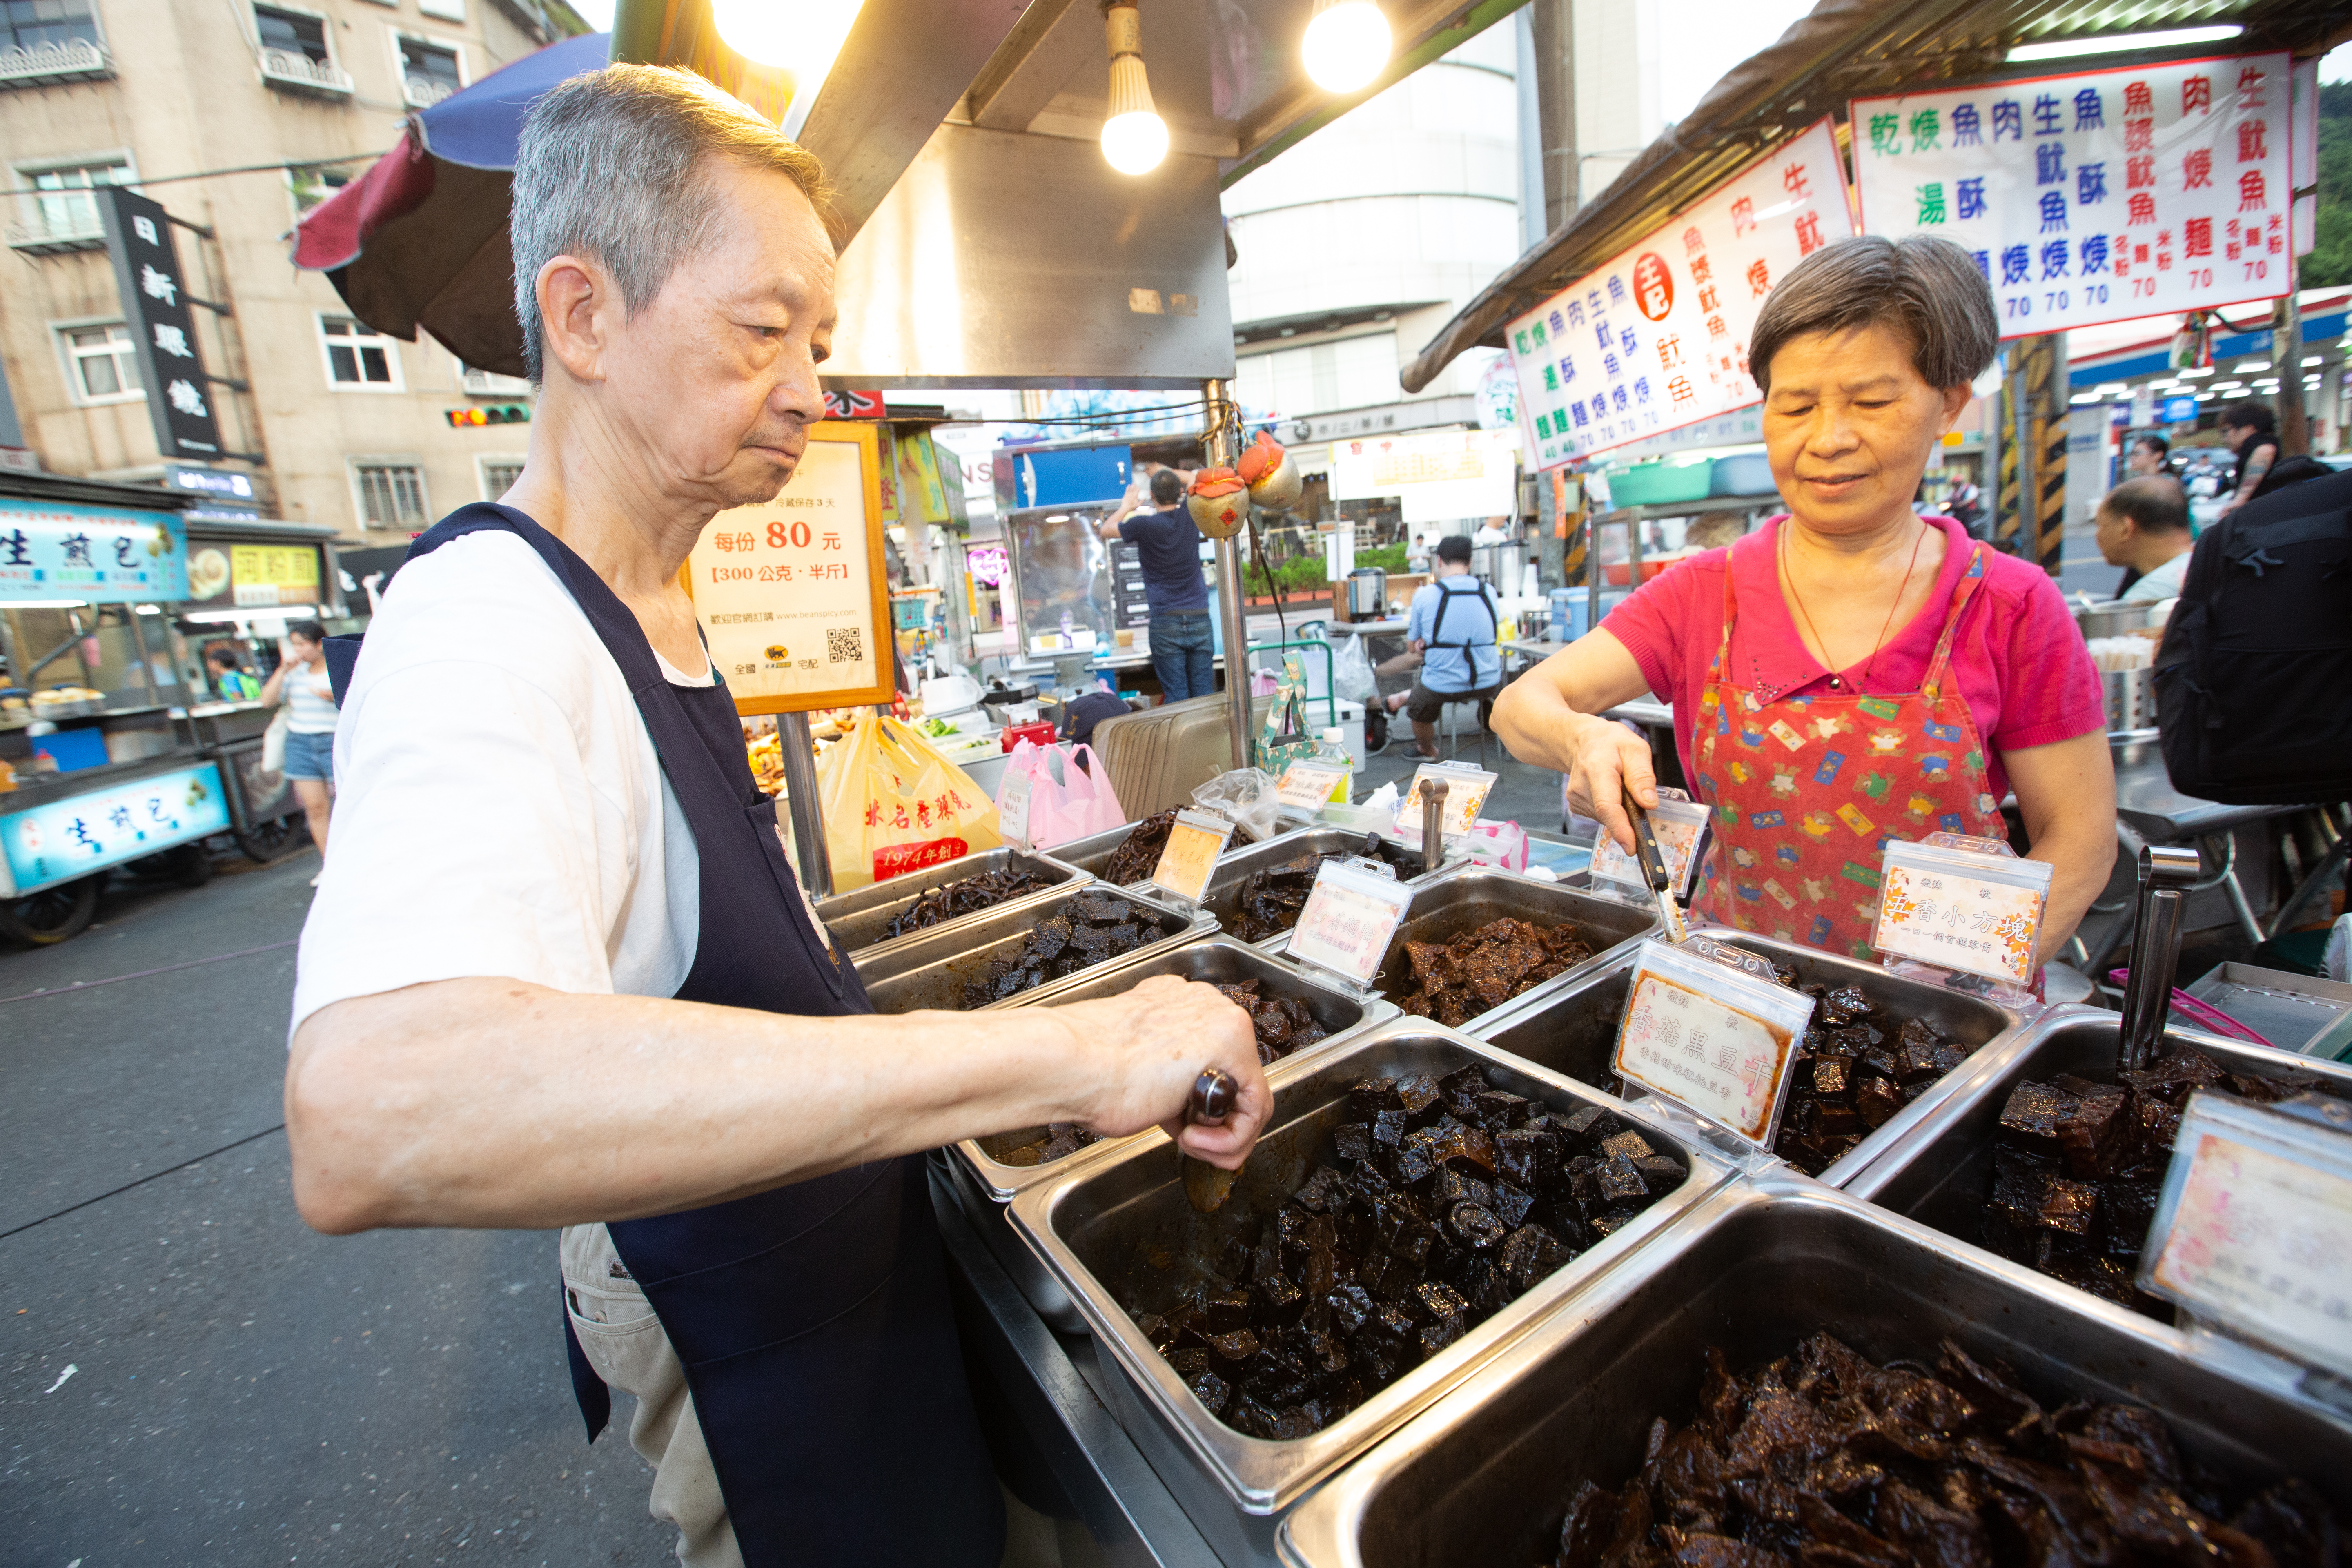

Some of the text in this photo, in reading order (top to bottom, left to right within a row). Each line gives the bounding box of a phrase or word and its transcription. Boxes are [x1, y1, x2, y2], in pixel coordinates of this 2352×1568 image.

[2266, 213, 2284, 255] 米粉
[2156, 229, 2173, 272] 米粉
[2189, 267, 2213, 291] 70
[2243, 260, 2267, 282] 70
[1637, 254, 1670, 319] 王記
[2085, 283, 2109, 305] 70
[2132, 276, 2156, 298] 70
[2007, 296, 2031, 318] 70
[2046, 290, 2070, 312] 70
[1726, 380, 1744, 399] 70
[1621, 419, 1636, 434] 70
[1644, 410, 1658, 426] 70
[1581, 433, 1595, 448] 70
[1601, 425, 1615, 440] 70
[1545, 445, 1557, 459] 40
[775, 498, 815, 508] 冷藏保存
[714, 521, 841, 552] 每份 80 元
[710, 609, 856, 625] 歡迎官網訂購 www.beanspicy.com
[735, 664, 756, 675] 全國
[798, 659, 818, 669] 宅配
[1921, 878, 1991, 899] 微辣 軟
[1313, 906, 1376, 943] 沙茶麵輪
[1887, 894, 2029, 944] 五香小方塊
[1901, 926, 1991, 953] 一口一個首選零嘴
[1666, 990, 1738, 1030] 微辣 軟
[1630, 1006, 1774, 1091] 香菇黑豆干
[1640, 1047, 1731, 1100] 香菇甜味襯托豆香
